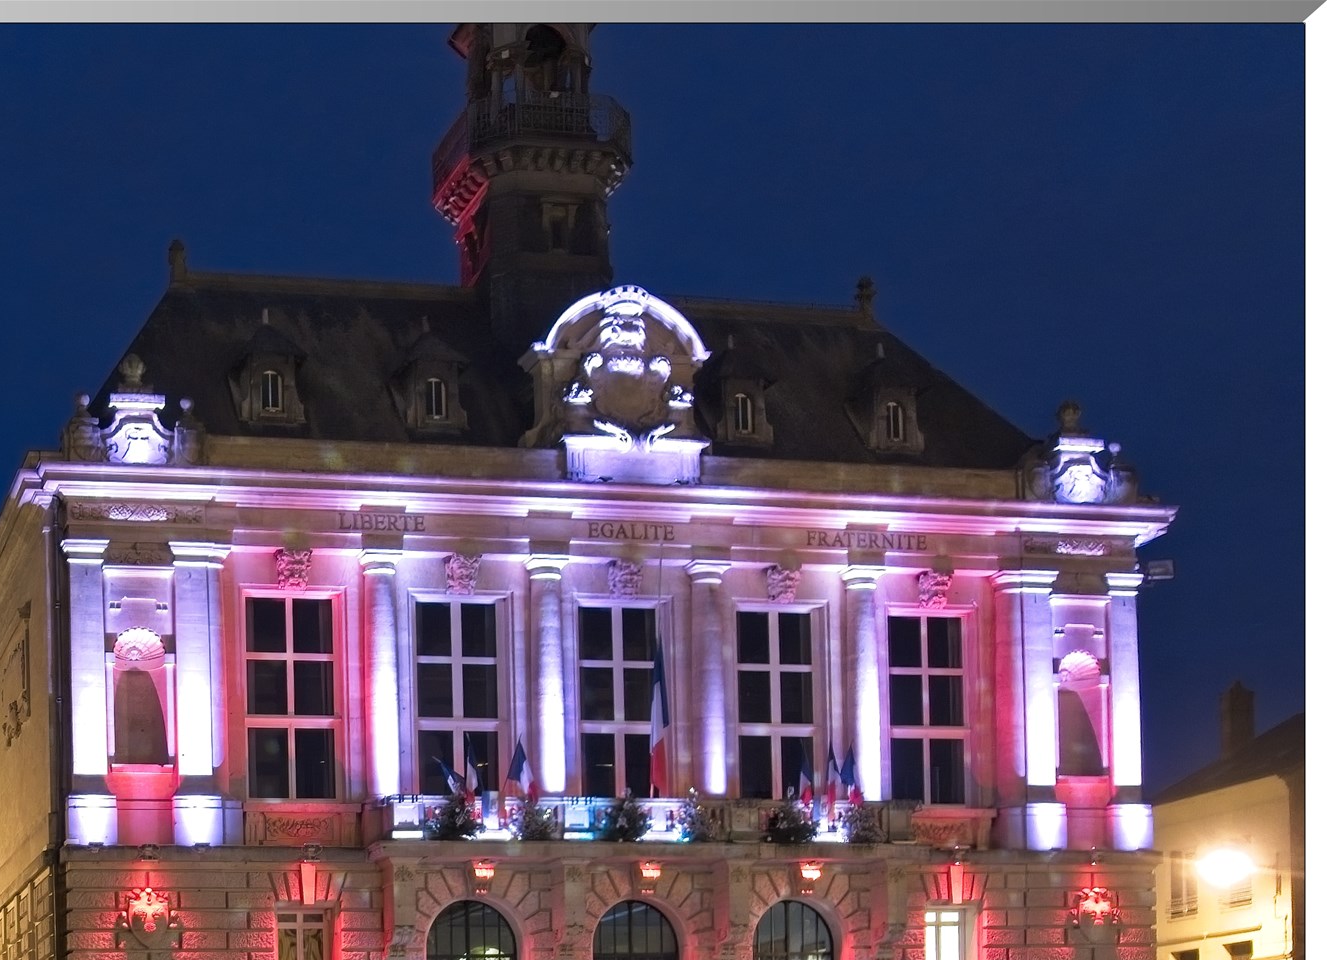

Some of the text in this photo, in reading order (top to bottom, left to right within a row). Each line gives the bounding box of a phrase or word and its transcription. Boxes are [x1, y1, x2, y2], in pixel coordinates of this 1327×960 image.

[338, 512, 928, 550] LIBERTE EGALITE FRATERNITE
